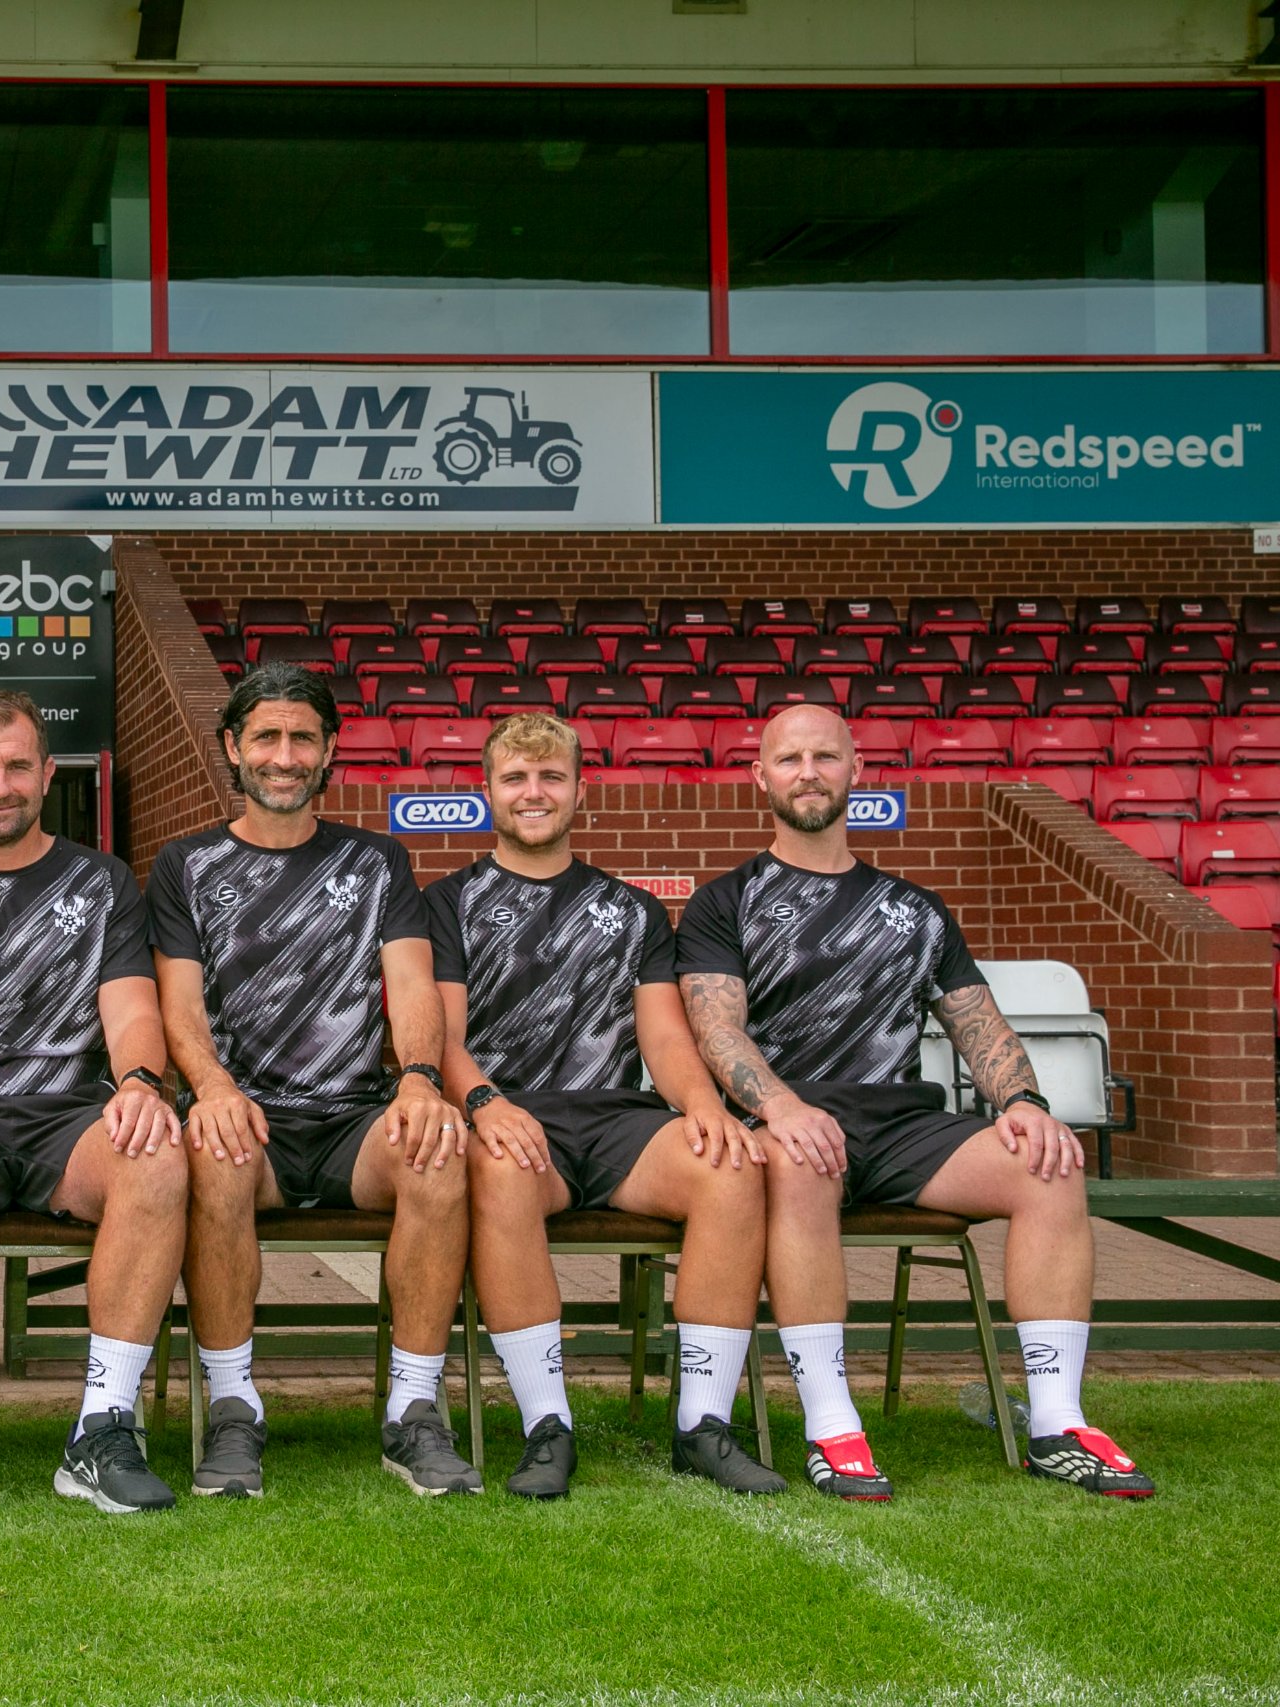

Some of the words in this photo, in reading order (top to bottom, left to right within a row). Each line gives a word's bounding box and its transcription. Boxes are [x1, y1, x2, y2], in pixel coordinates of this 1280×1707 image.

[91, 385, 431, 430] ADAM
[975, 424, 1244, 479] Redspeed
[389, 467, 423, 480] LTD
[976, 472, 1099, 488] International
[105, 488, 440, 506] www.adamhewitt.com
